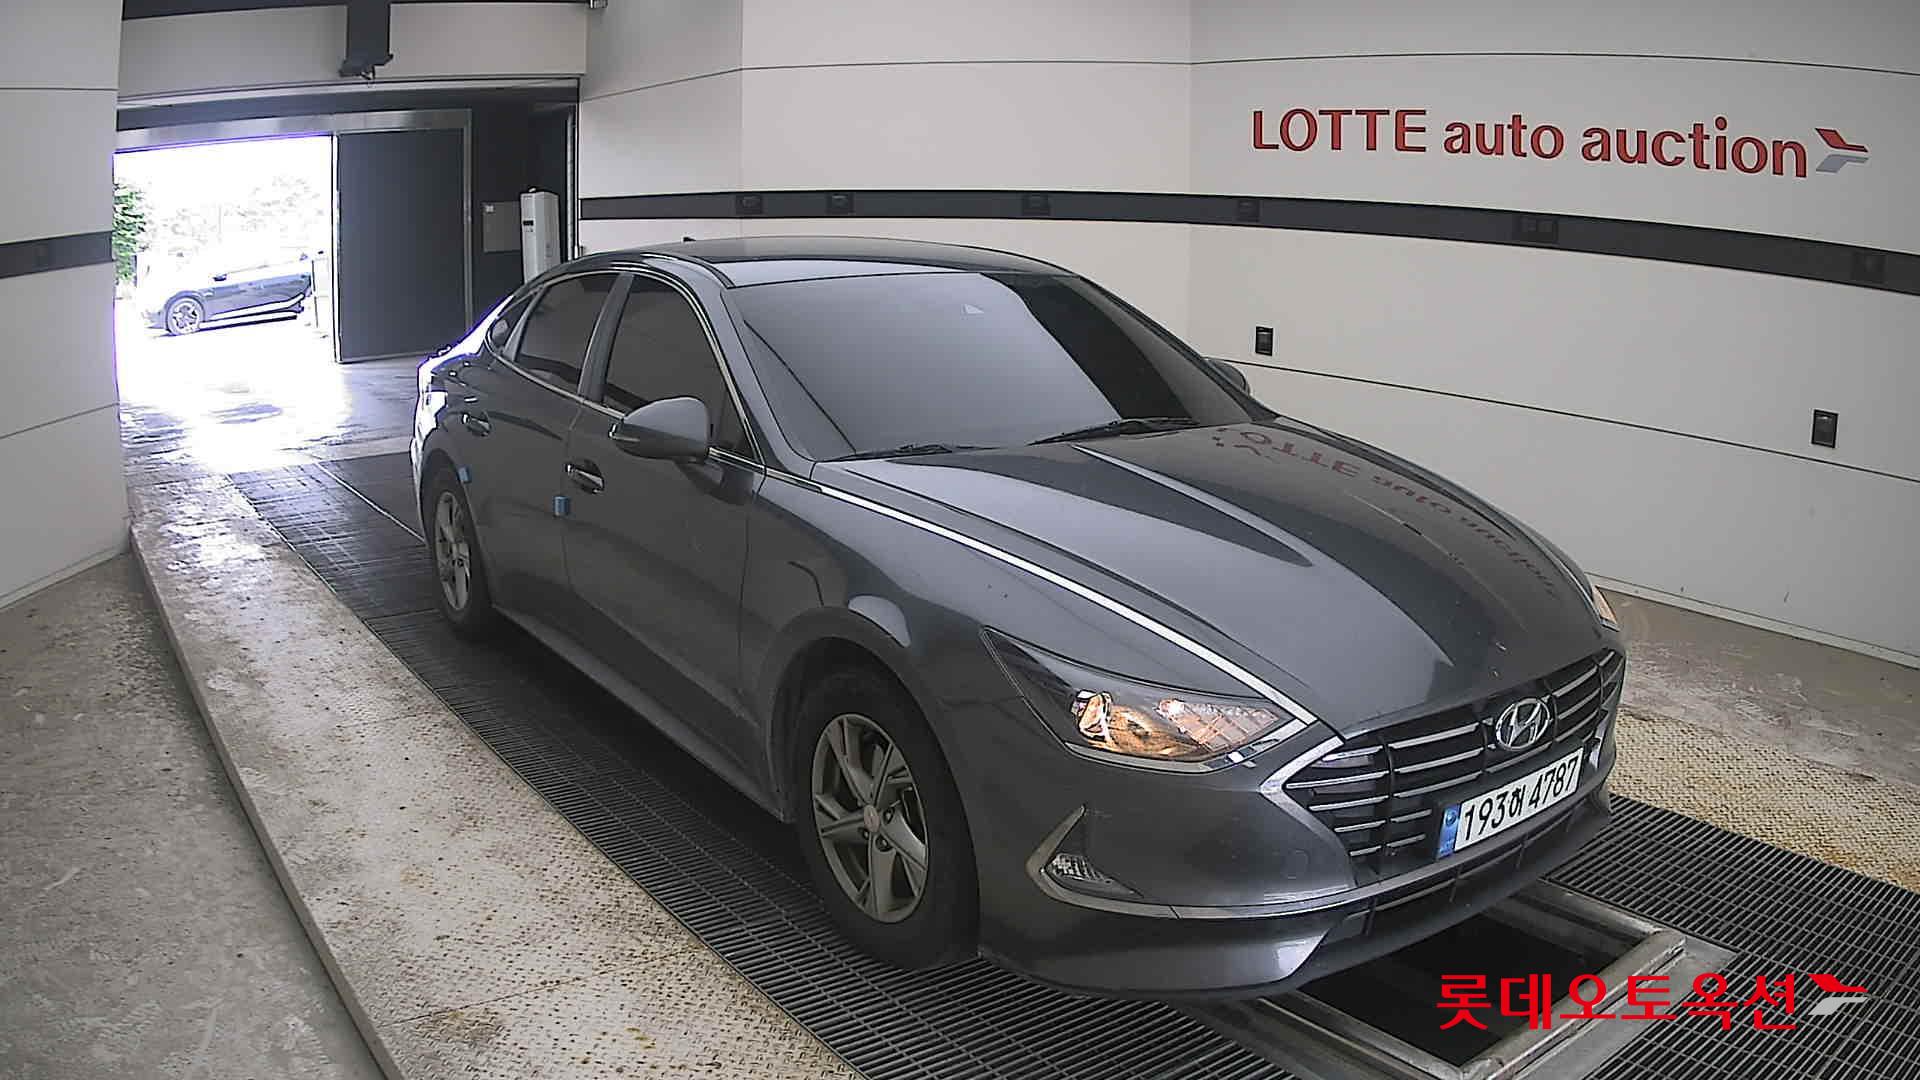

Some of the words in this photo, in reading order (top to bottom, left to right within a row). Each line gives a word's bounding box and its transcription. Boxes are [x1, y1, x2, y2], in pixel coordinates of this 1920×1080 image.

[1252, 109, 1427, 153] LOTTE
[1443, 114, 1566, 160] auto
[1581, 116, 1808, 179] auction
[1527, 755, 1579, 810] 4787
